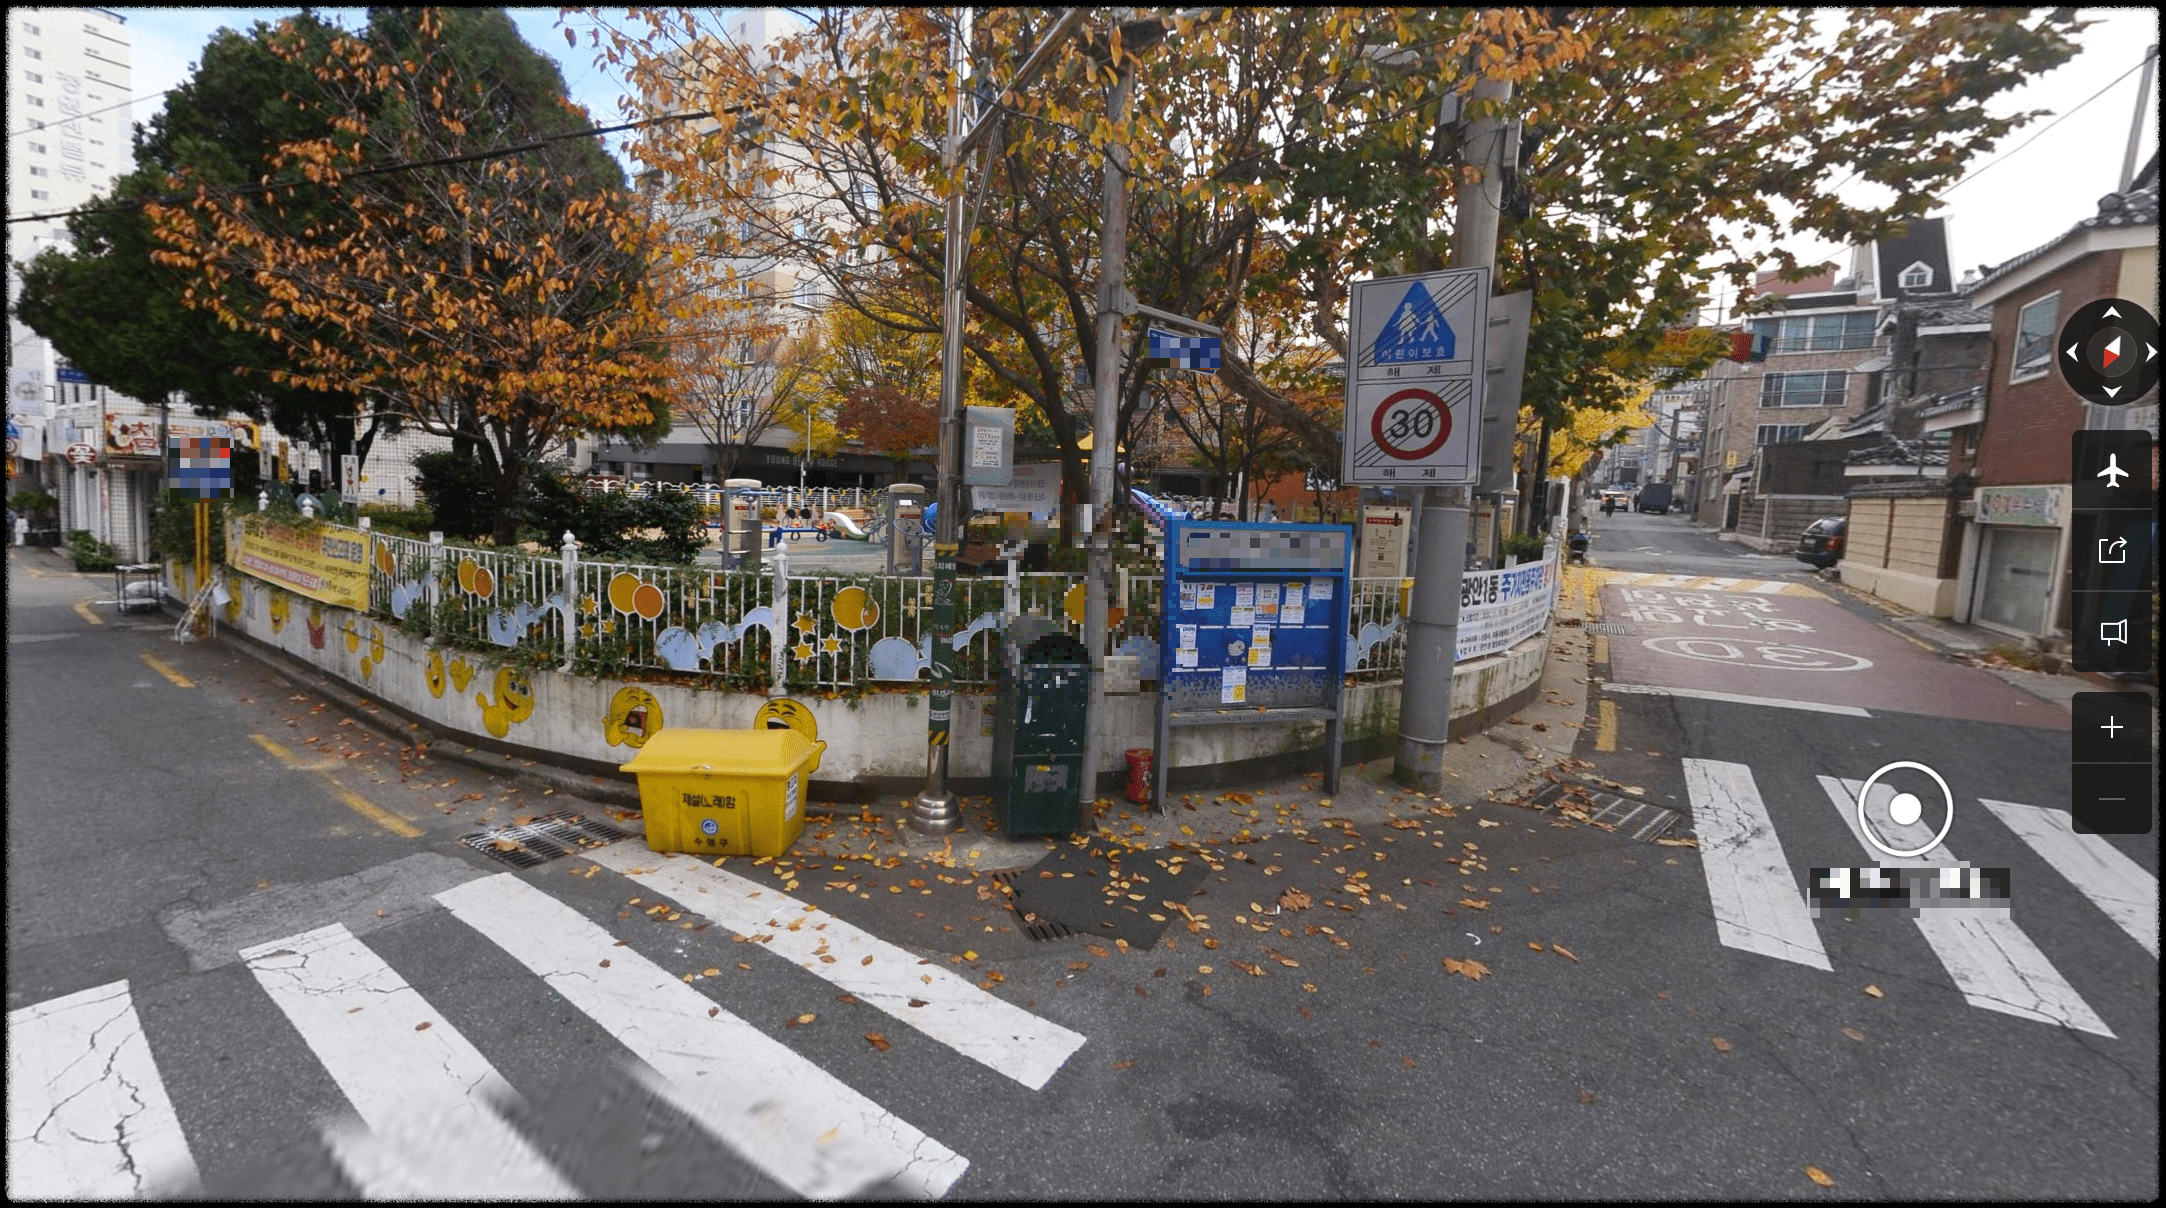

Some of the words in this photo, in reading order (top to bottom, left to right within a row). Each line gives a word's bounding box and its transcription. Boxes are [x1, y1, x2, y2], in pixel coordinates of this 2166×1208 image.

[1381, 345, 1447, 360] 어린이보호
[1391, 409, 1434, 438] 30
[766, 454, 790, 465] YOUNG
[1461, 574, 1499, 608] 광안1동
[1676, 640, 1836, 667] 30
[694, 837, 729, 847] 수영구
